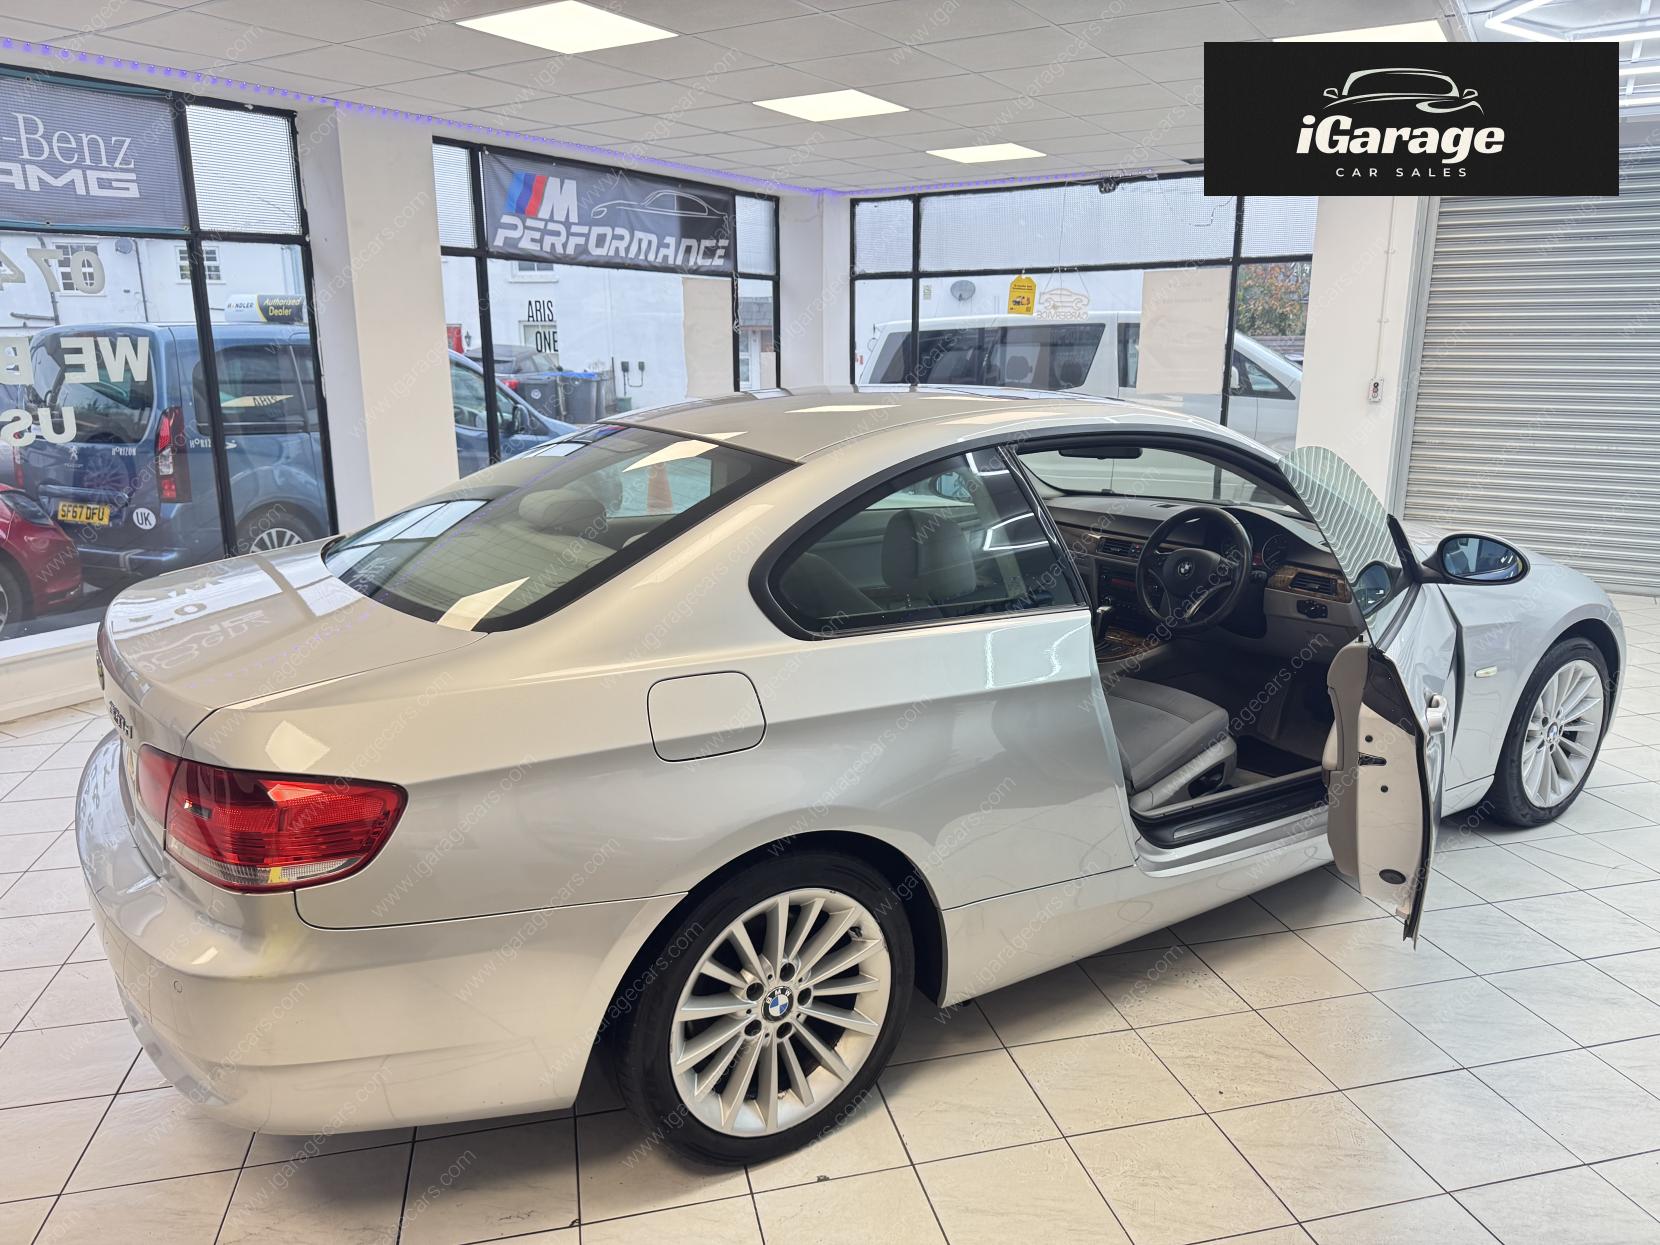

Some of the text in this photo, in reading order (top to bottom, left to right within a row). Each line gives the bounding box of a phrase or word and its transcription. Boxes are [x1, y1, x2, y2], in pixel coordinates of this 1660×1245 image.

[538, 176, 579, 224] M
[493, 215, 729, 267] PERFORMANCE
[268, 306, 292, 317] Dealer
[189, 438, 212, 449] HORIZ
[60, 503, 105, 522] SF67 DFU
[136, 510, 153, 527] UK
